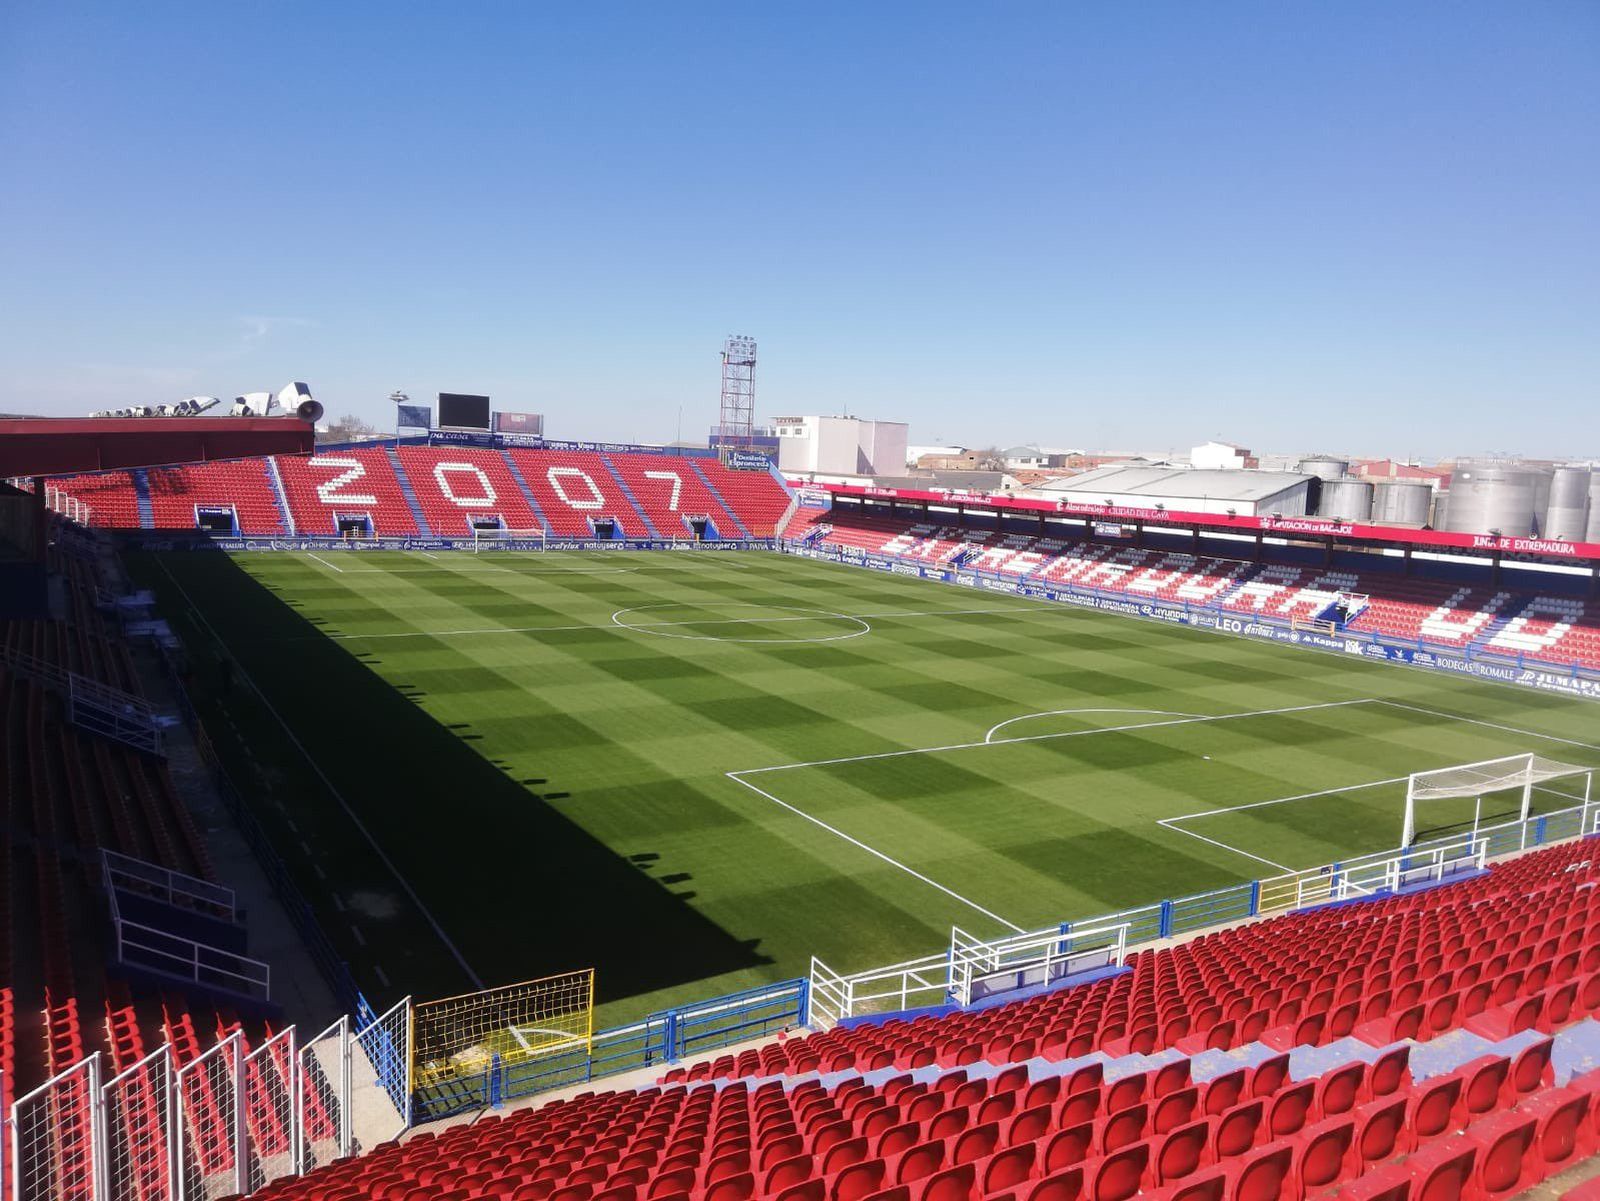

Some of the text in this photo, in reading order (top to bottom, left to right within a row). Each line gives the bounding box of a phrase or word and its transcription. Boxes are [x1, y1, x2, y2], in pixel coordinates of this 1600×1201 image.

[1500, 539, 1510, 549] DE
[1514, 540, 1575, 554] EXTREMADURA
[1155, 608, 1188, 620] HYUNDAI
[1215, 617, 1241, 632] LEO
[1313, 637, 1343, 648] Kappa
[1437, 657, 1473, 672] BODEGAS
[1480, 666, 1515, 680] ROMALE
